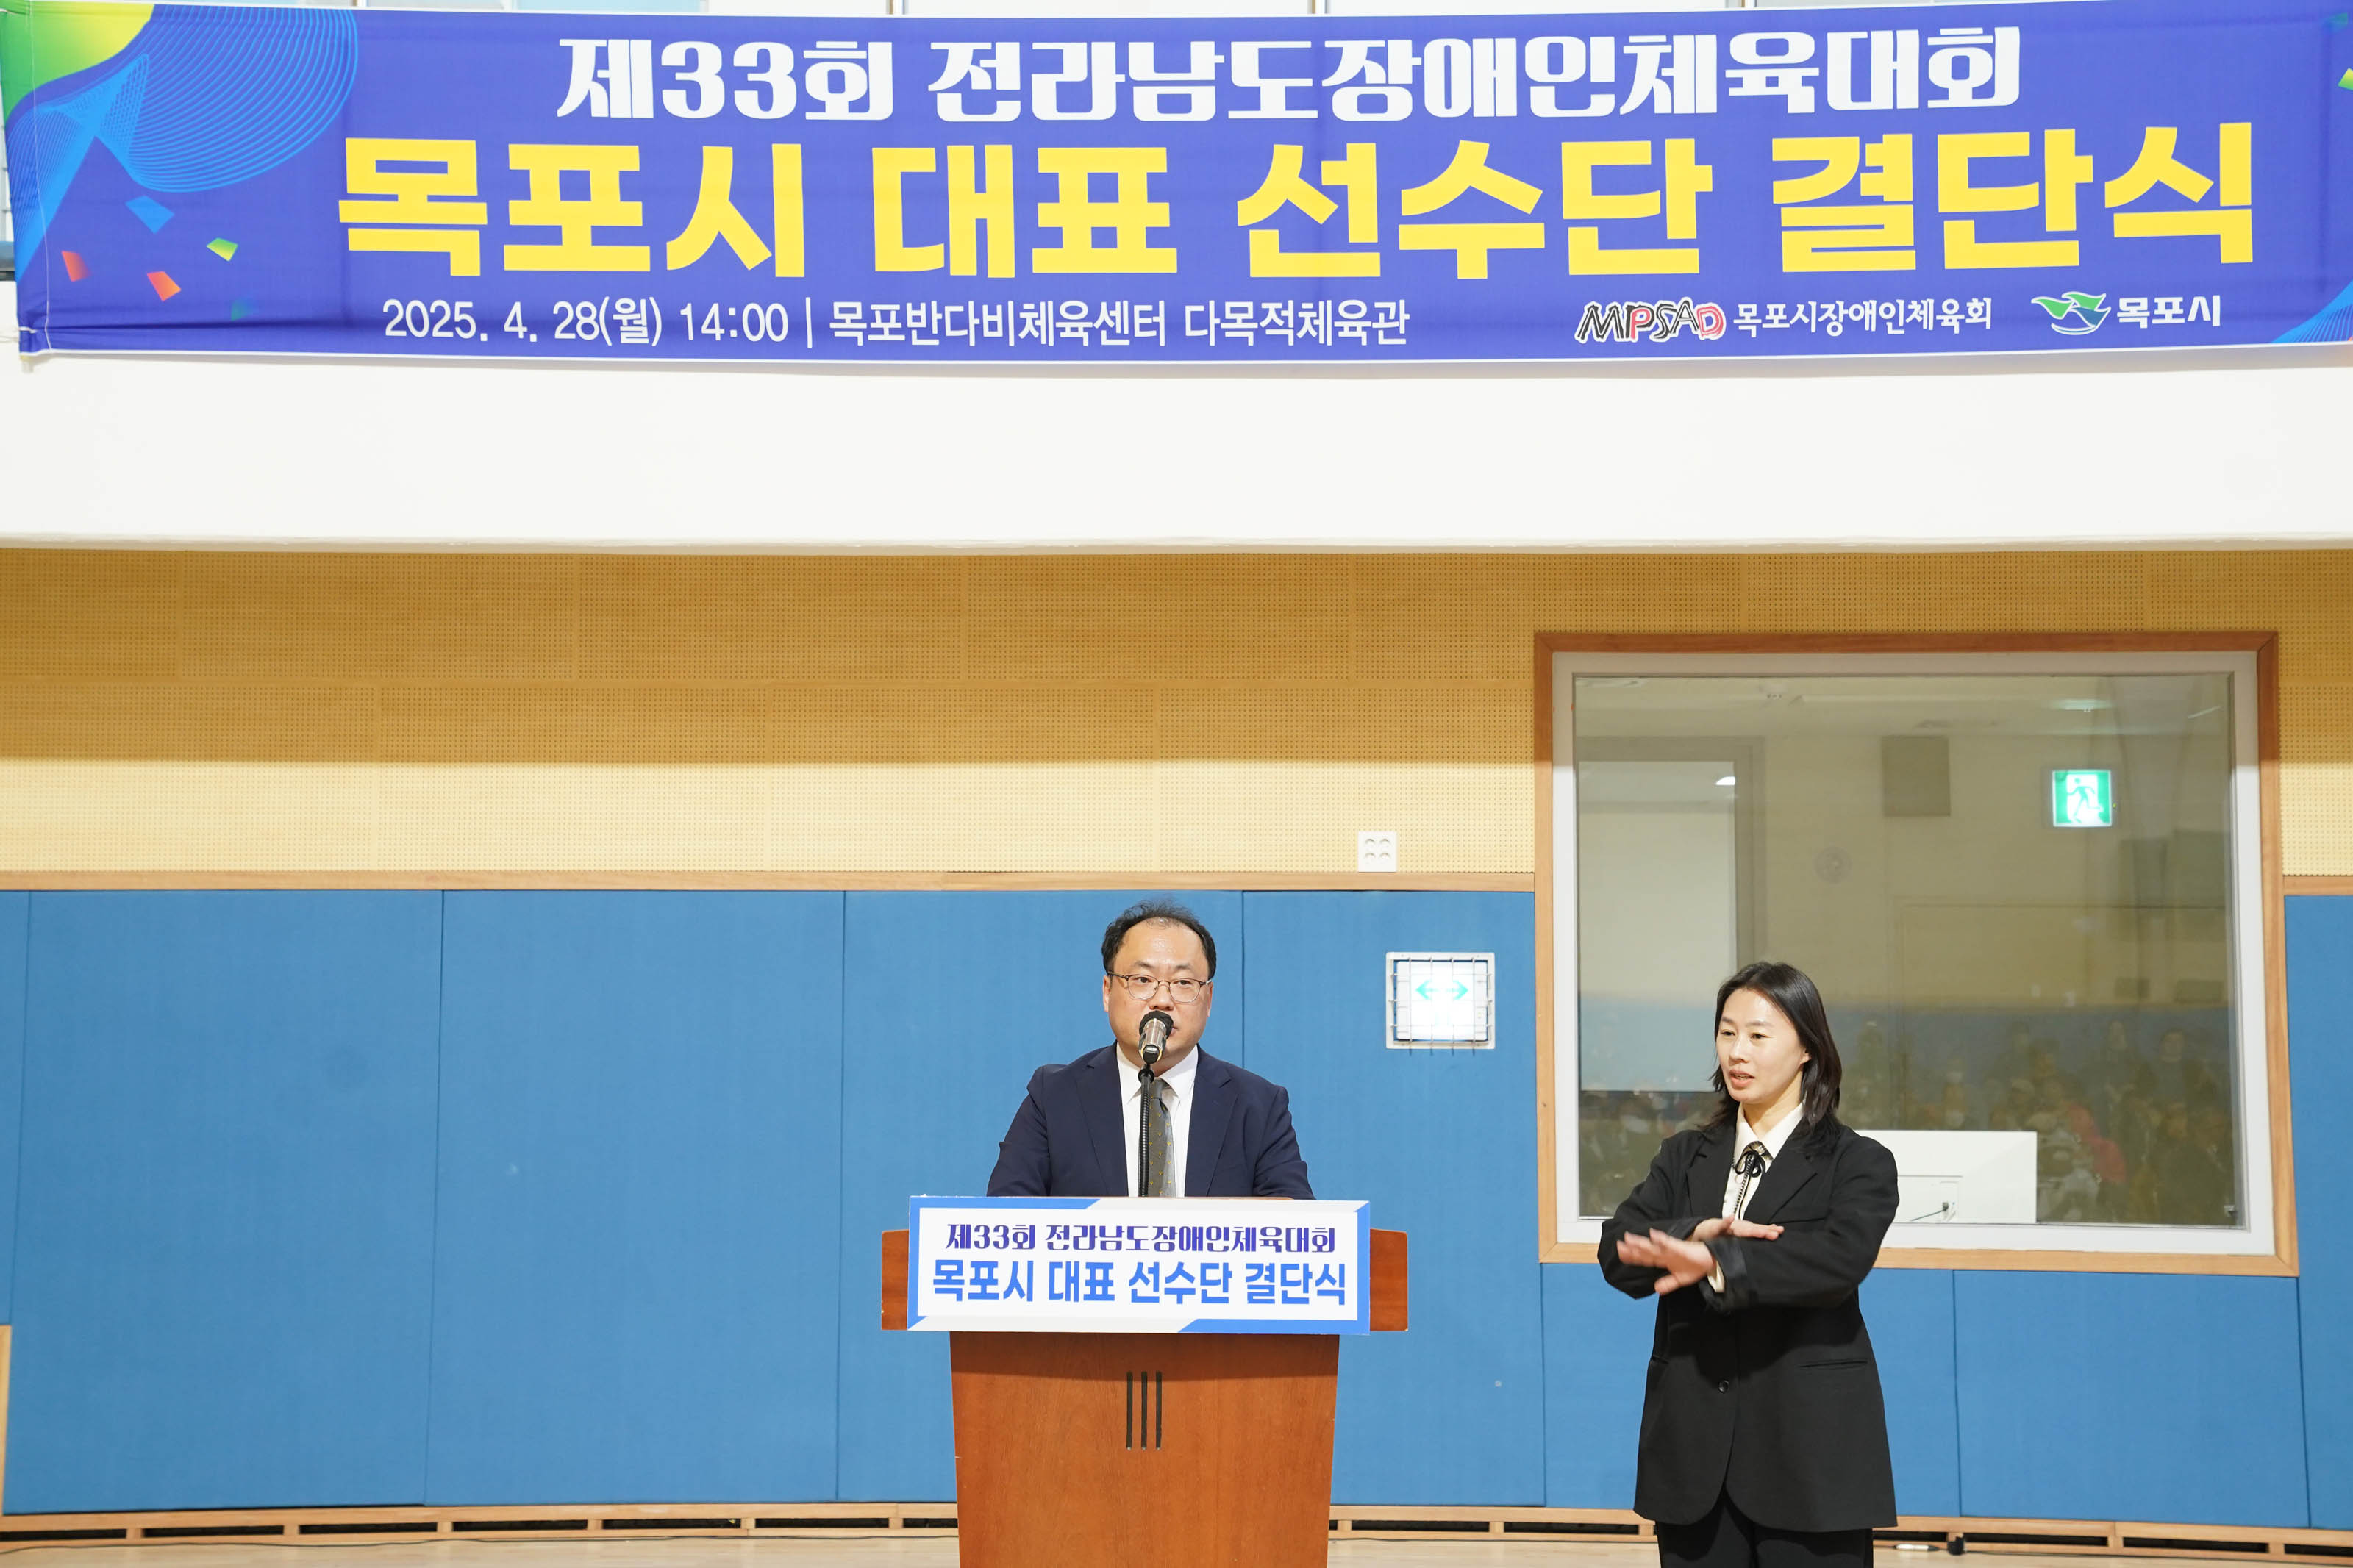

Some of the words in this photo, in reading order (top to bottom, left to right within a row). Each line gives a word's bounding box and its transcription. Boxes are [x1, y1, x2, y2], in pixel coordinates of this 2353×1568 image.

[557, 38, 894, 121] 제33회
[927, 26, 2021, 122] 전라남도장애인체육대회
[338, 137, 804, 277] 목포시
[872, 144, 1177, 279] 대표
[1238, 138, 1713, 279] 선수단
[1772, 123, 2253, 272] 결단식
[382, 298, 488, 342] 2025.
[504, 301, 538, 343] 4.
[553, 296, 662, 347] 28(월)
[680, 302, 789, 342] 14:00
[829, 300, 1165, 347] 목포반다비체육센터
[1185, 299, 1410, 346] 다목적체육관
[1574, 296, 1727, 344] MPSAD
[1733, 297, 1992, 338] 목포시장애인체육회
[2116, 295, 2221, 329] 목포시
[946, 1224, 1036, 1250] 제33회
[1046, 1225, 1335, 1253] 전라남도장애인체육대회
[932, 1259, 1034, 1302] 목포시
[1048, 1261, 1115, 1303] 대표
[1129, 1261, 1233, 1305] 선수단
[1245, 1262, 1346, 1306] 결단식
